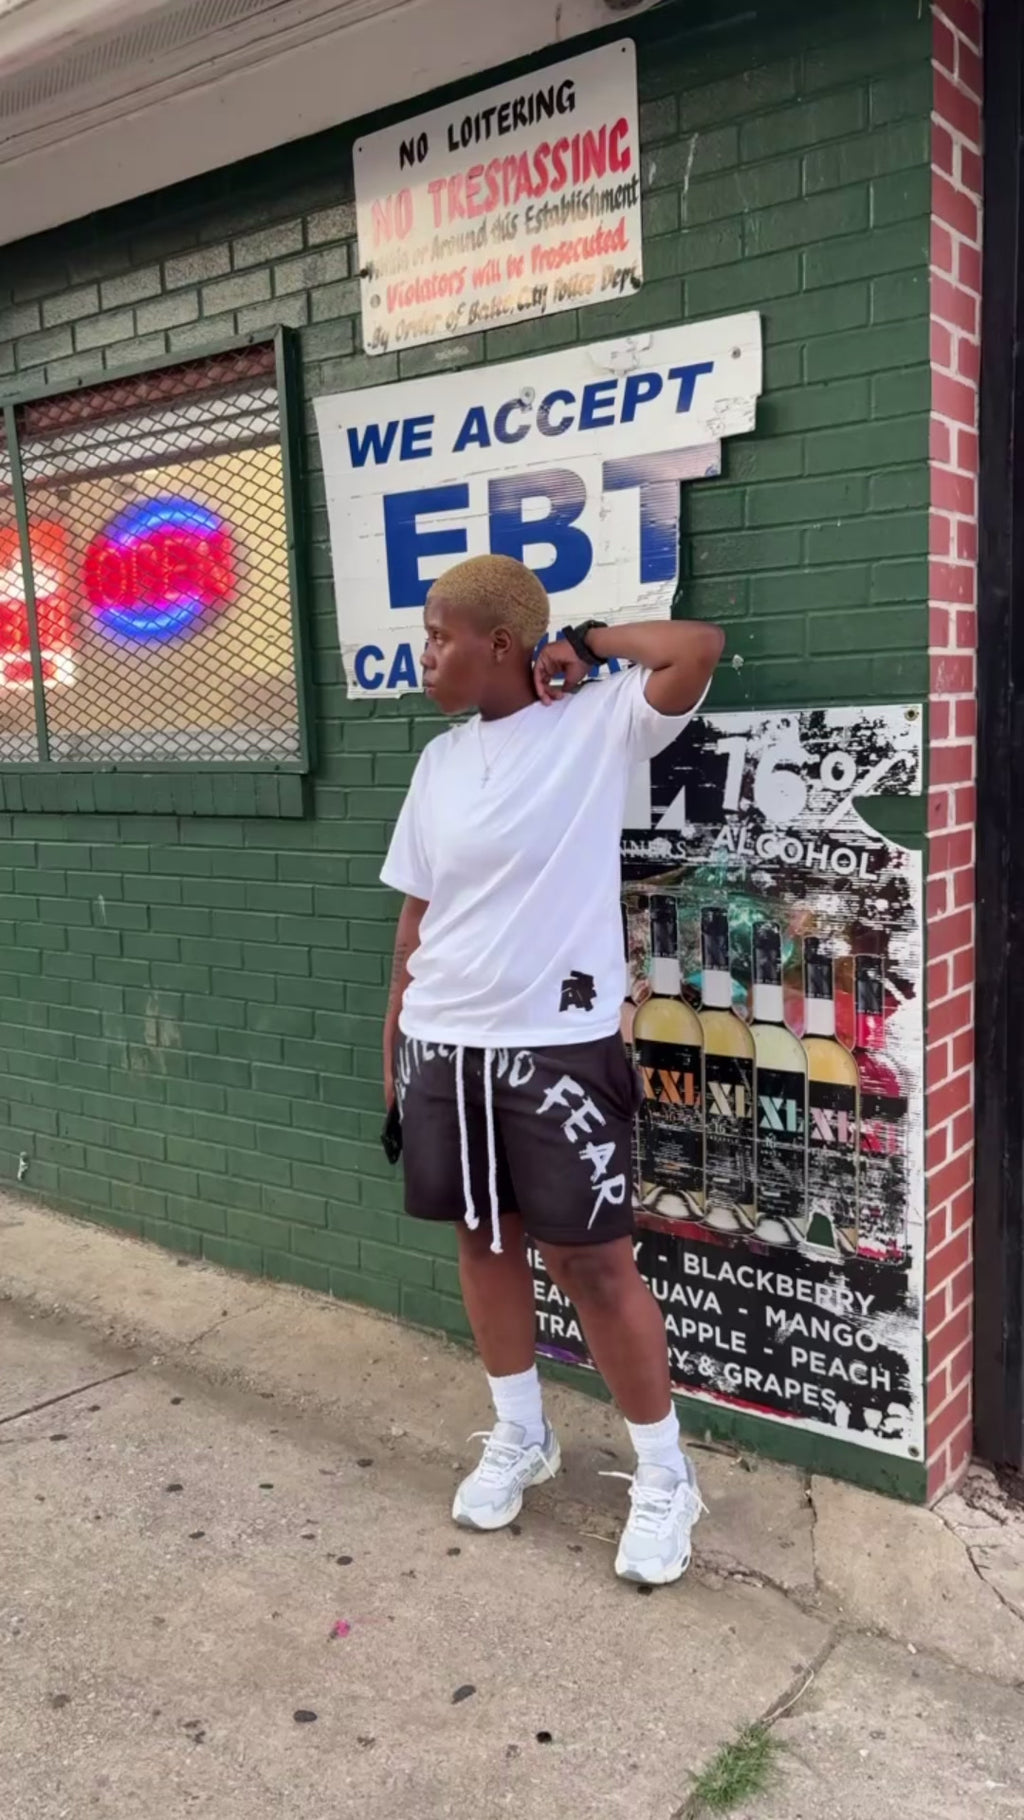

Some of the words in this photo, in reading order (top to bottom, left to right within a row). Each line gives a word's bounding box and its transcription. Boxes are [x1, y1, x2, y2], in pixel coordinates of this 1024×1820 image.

[400, 132, 428, 170] NO
[448, 79, 576, 152] LOITERING
[370, 188, 414, 248] NO
[427, 117, 632, 228] TRESPASSING
[431, 214, 488, 263] Around
[525, 173, 640, 236] Establishment
[386, 266, 467, 315] Violators
[472, 258, 502, 290] will
[506, 254, 525, 280] be
[531, 215, 629, 275] Prosecuted
[346, 414, 434, 468] WE
[452, 361, 714, 452] ACCEPT
[85, 530, 236, 608] OPEN
[382, 438, 721, 610] EBT
[713, 826, 878, 881] ALCOHOL
[536, 1075, 626, 1231] FEAR
[683, 1251, 876, 1317] BLACKBERRY
[765, 1305, 878, 1353] MANGO
[723, 1362, 839, 1415] GRAPES
[791, 1346, 892, 1393] PEACH
